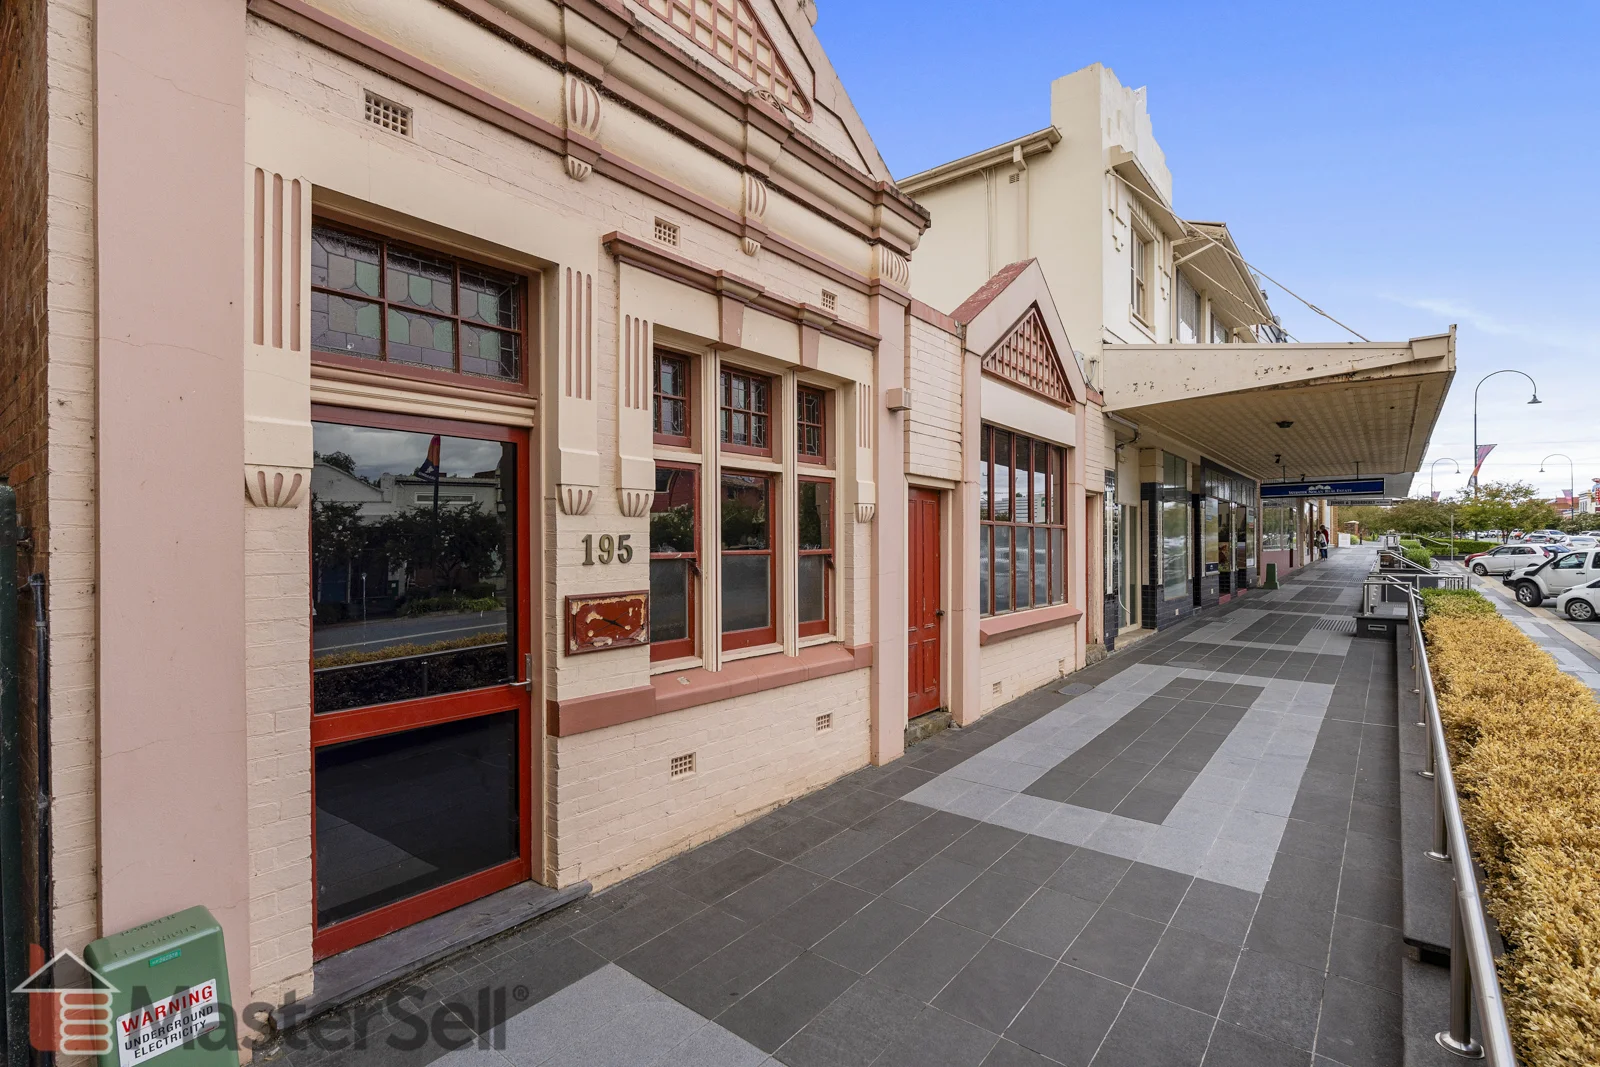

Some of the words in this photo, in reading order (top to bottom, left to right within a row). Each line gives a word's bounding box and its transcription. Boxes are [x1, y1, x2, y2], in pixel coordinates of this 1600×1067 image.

[581, 533, 633, 566] 195
[121, 985, 213, 1033] WARNING
[124, 1005, 213, 1051] UNDERGROUND
[134, 1020, 207, 1059] ELECTRICITY
